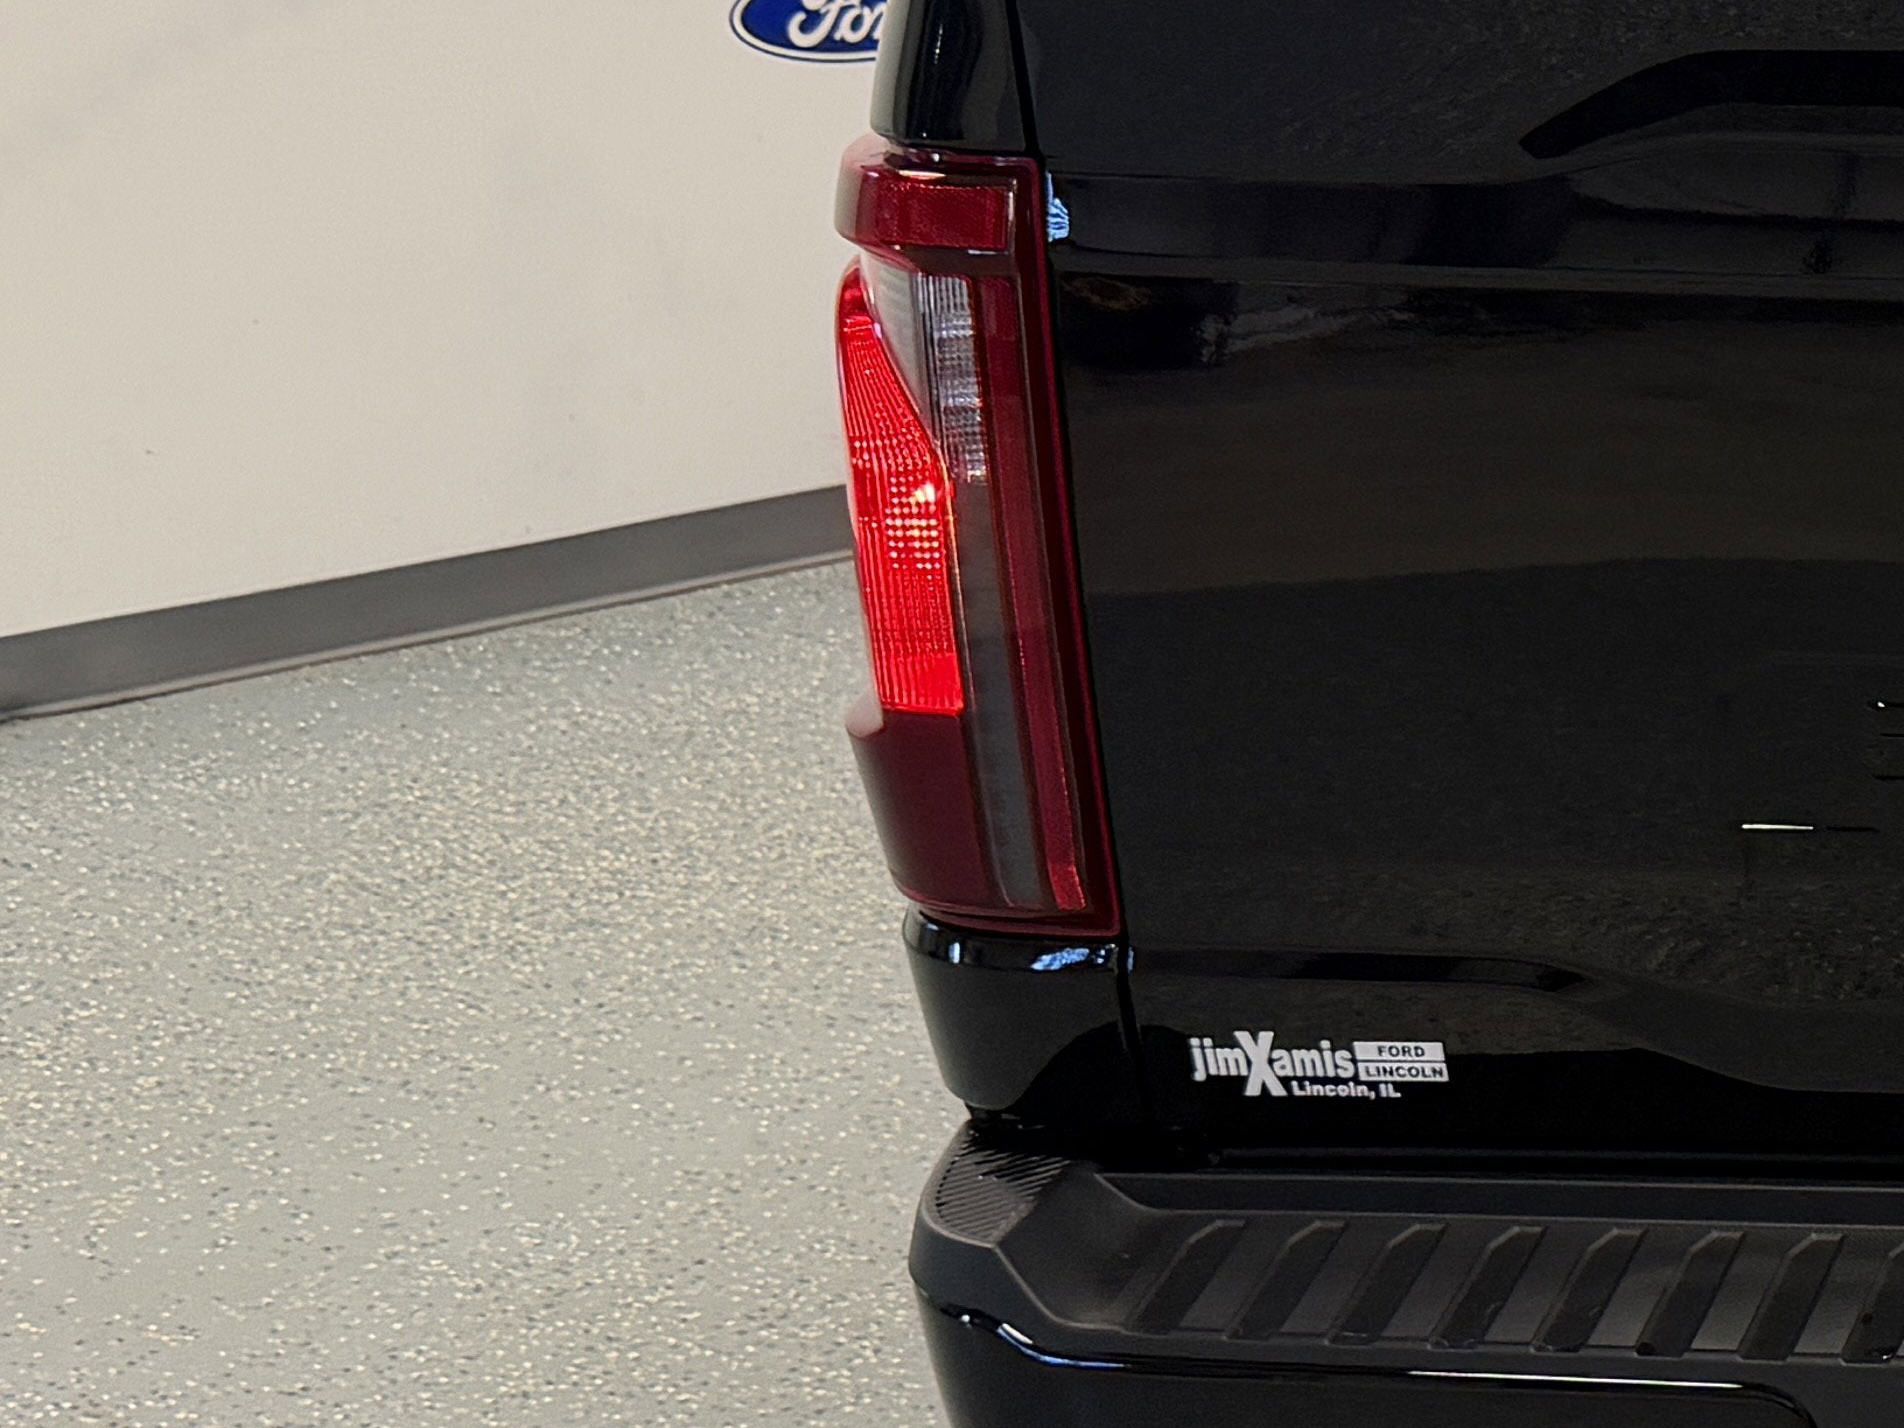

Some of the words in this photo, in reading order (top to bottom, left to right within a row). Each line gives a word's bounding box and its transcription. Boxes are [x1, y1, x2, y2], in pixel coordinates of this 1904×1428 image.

[1378, 1045, 1426, 1058] FORD
[1364, 1065, 1445, 1079] LINCOLN
[1290, 1081, 1377, 1101] Lincoln,
[1380, 1082, 1402, 1099] IL
